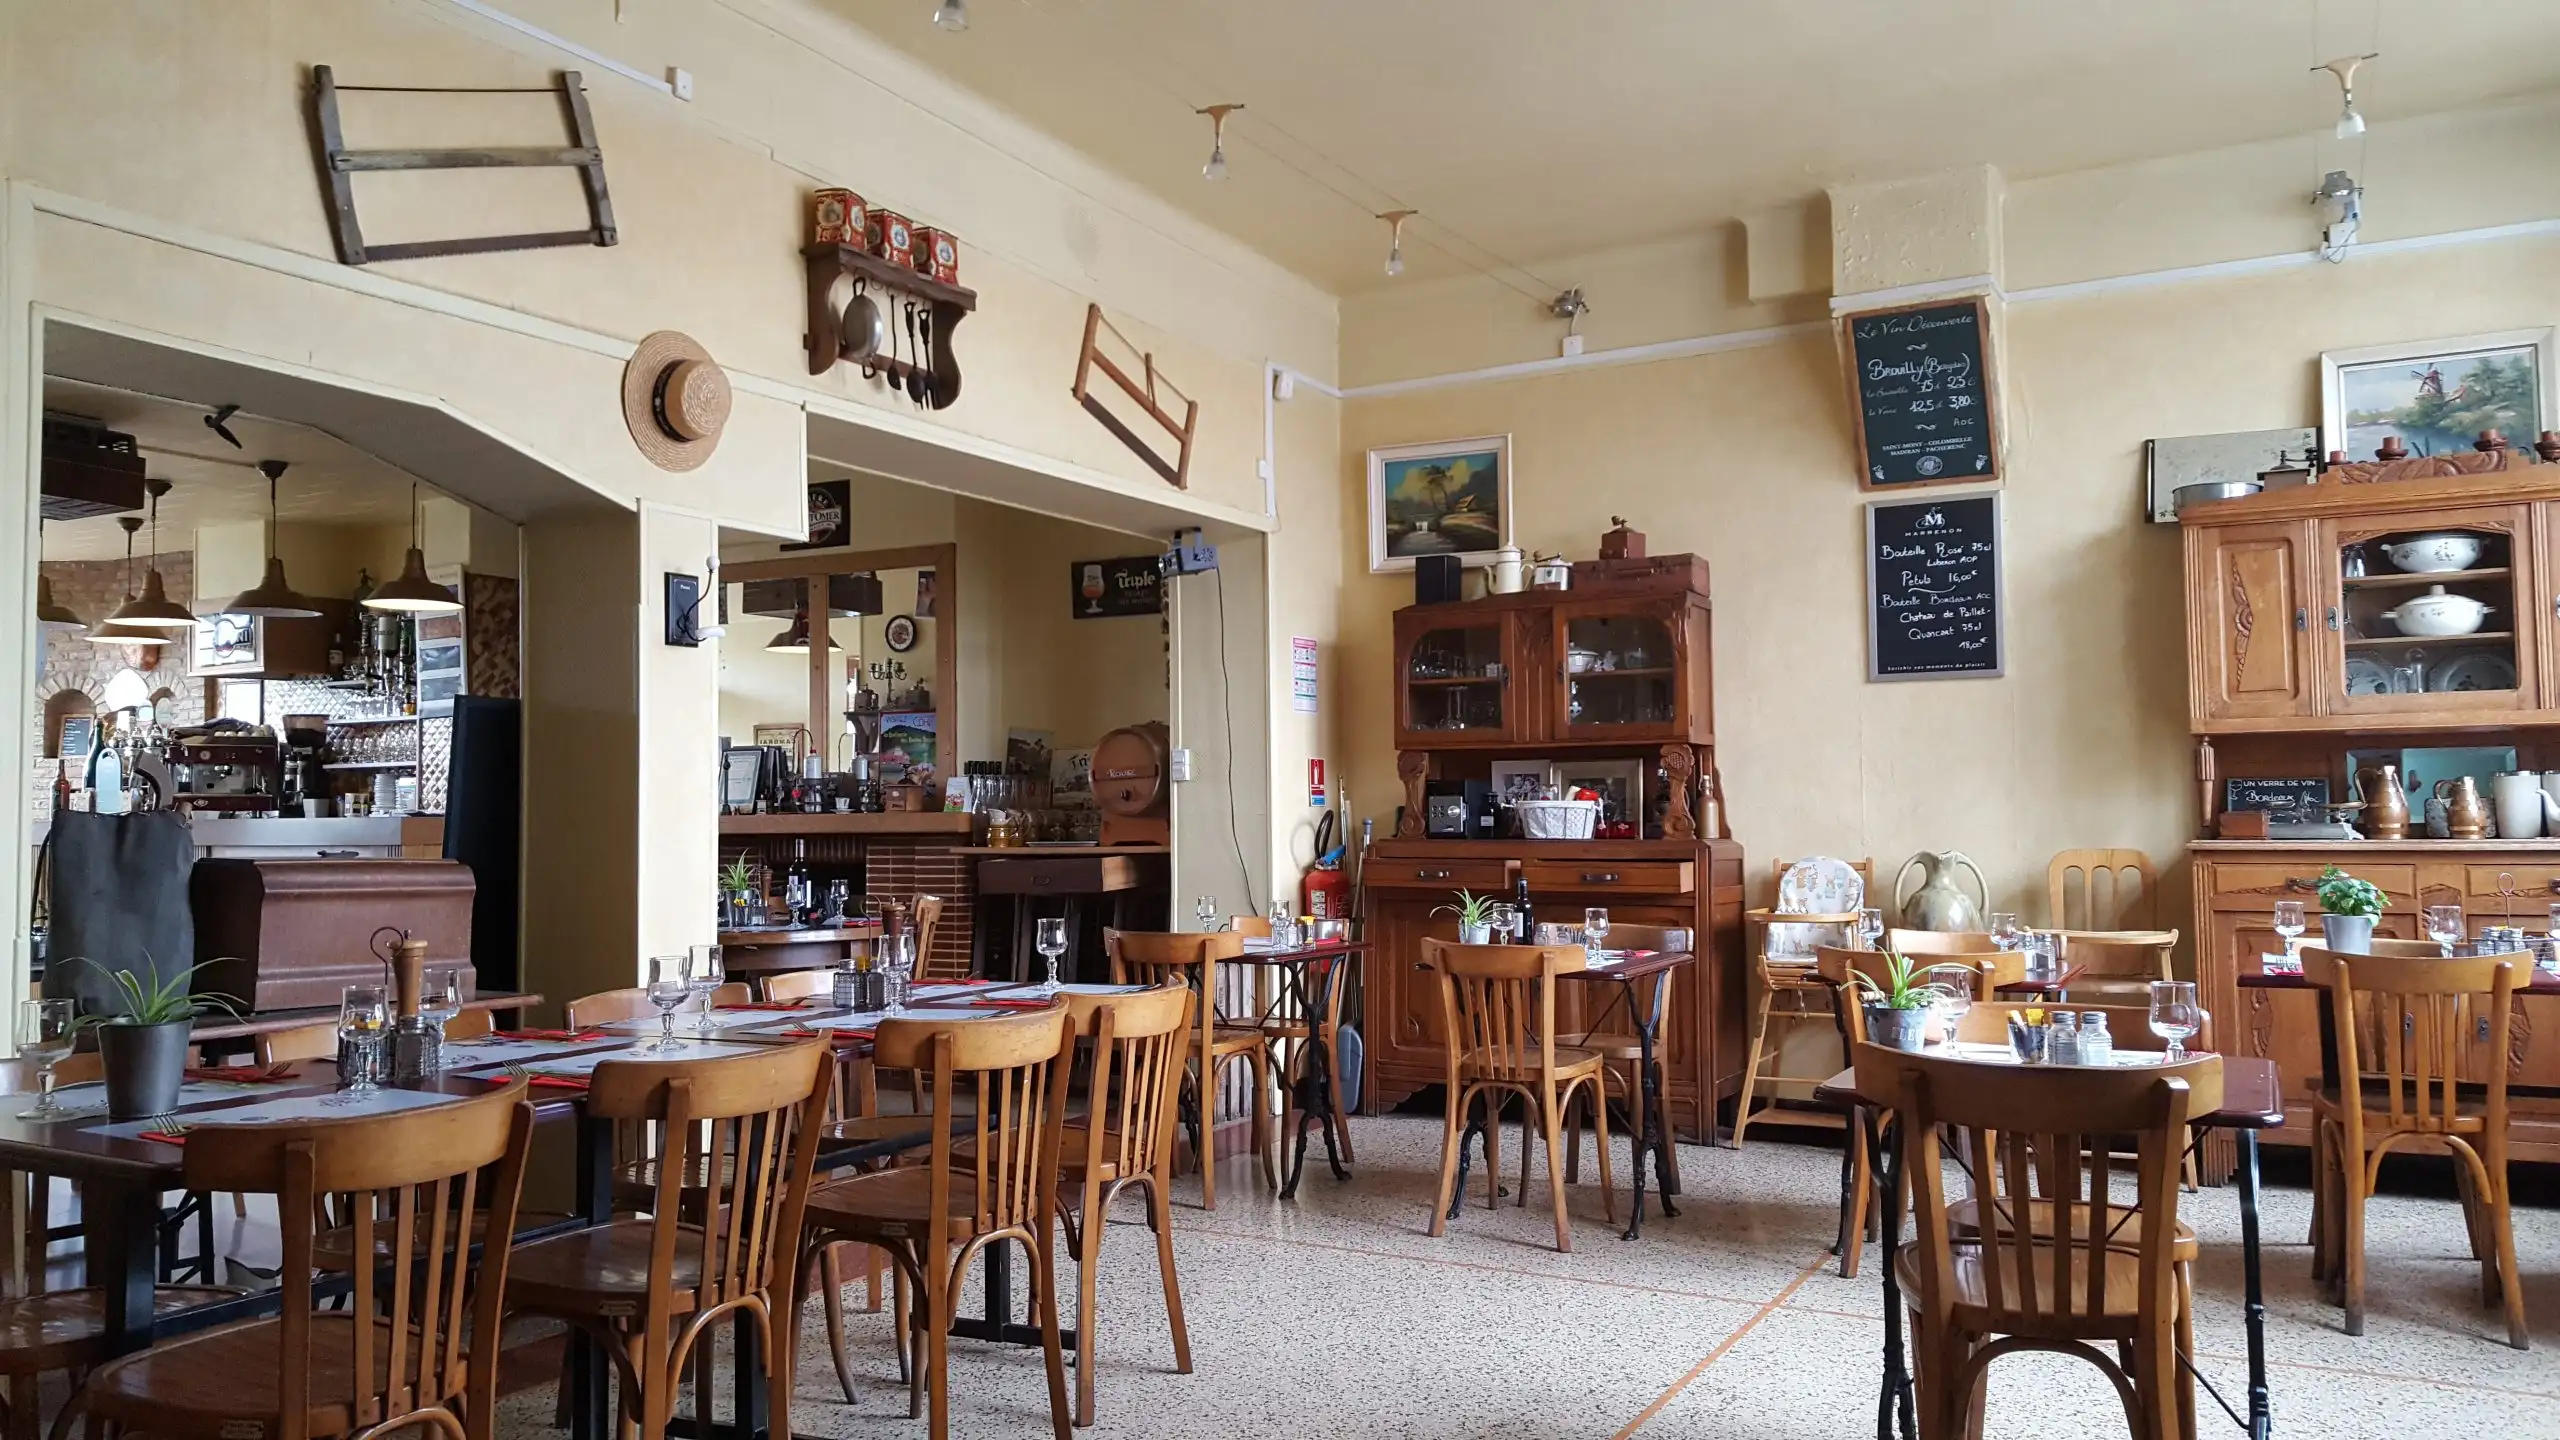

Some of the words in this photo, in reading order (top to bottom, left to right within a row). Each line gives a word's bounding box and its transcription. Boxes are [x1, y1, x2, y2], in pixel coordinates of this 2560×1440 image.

[1881, 319, 1905, 335] Vin
[1880, 545, 1926, 559] Bouteille
[1935, 541, 1963, 557] Rosé
[1960, 555, 1978, 564] AOP
[1114, 568, 1156, 590] Triple
[1880, 593, 1921, 608] Bouteille
[1929, 593, 1972, 605] Bordeaux
[1943, 610, 1954, 618] de
[1067, 753, 1091, 770] Tri
[2245, 789, 2295, 802] Bordeaux
